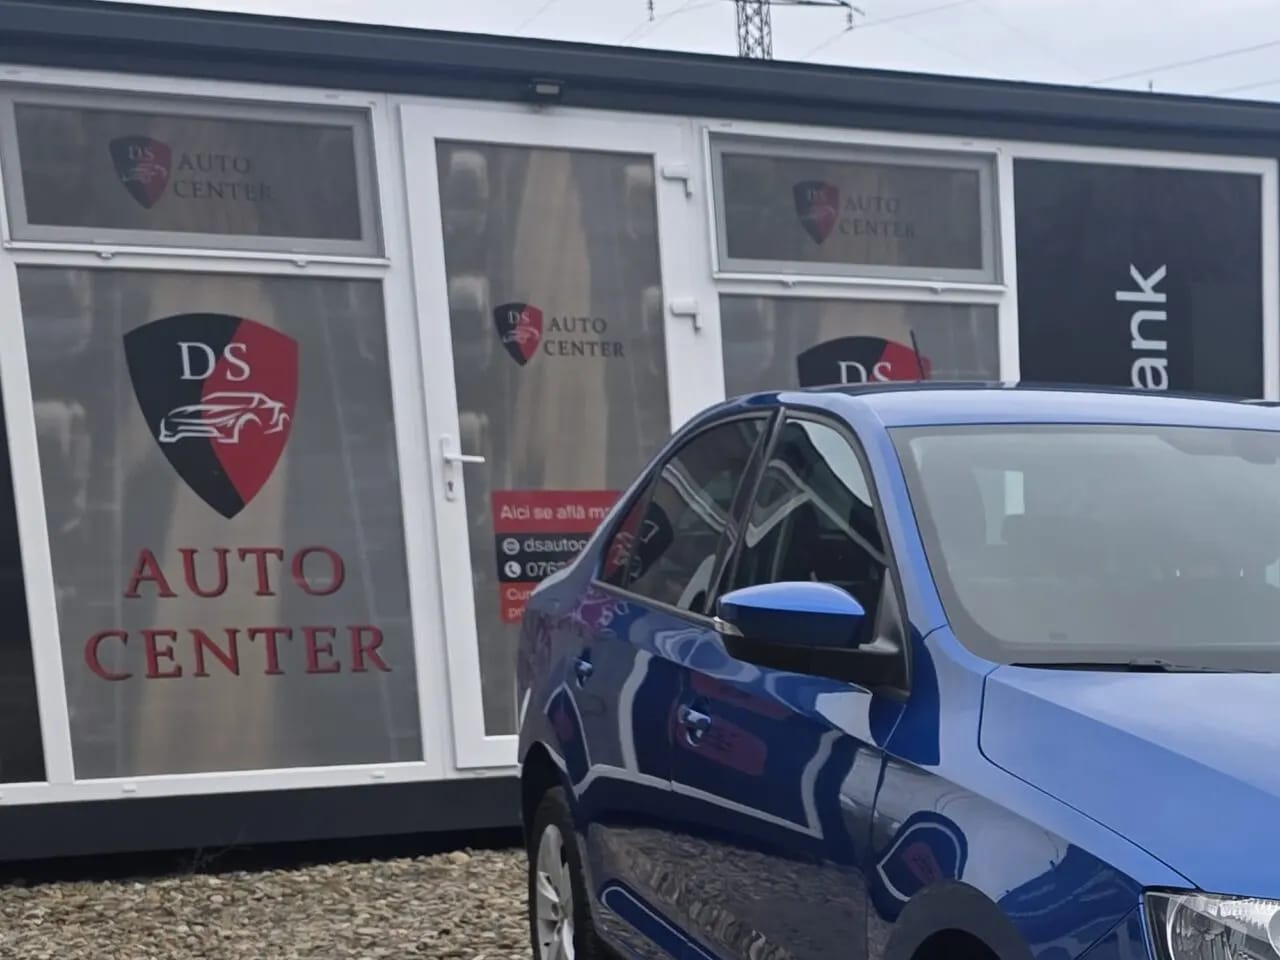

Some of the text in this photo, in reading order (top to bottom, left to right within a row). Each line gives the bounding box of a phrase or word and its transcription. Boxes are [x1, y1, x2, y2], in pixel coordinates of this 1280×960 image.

[177, 152, 251, 174] AUTO
[174, 180, 272, 201] CENTER
[845, 195, 901, 213] AUTO
[548, 317, 608, 334] AUTO
[543, 340, 626, 358] CENTER
[177, 341, 251, 382] DS
[500, 504, 531, 520] Aici
[534, 506, 553, 520] se
[589, 507, 612, 519] m
[123, 545, 347, 598] AUTO
[526, 560, 566, 576] 076
[83, 625, 392, 682] CENTER
